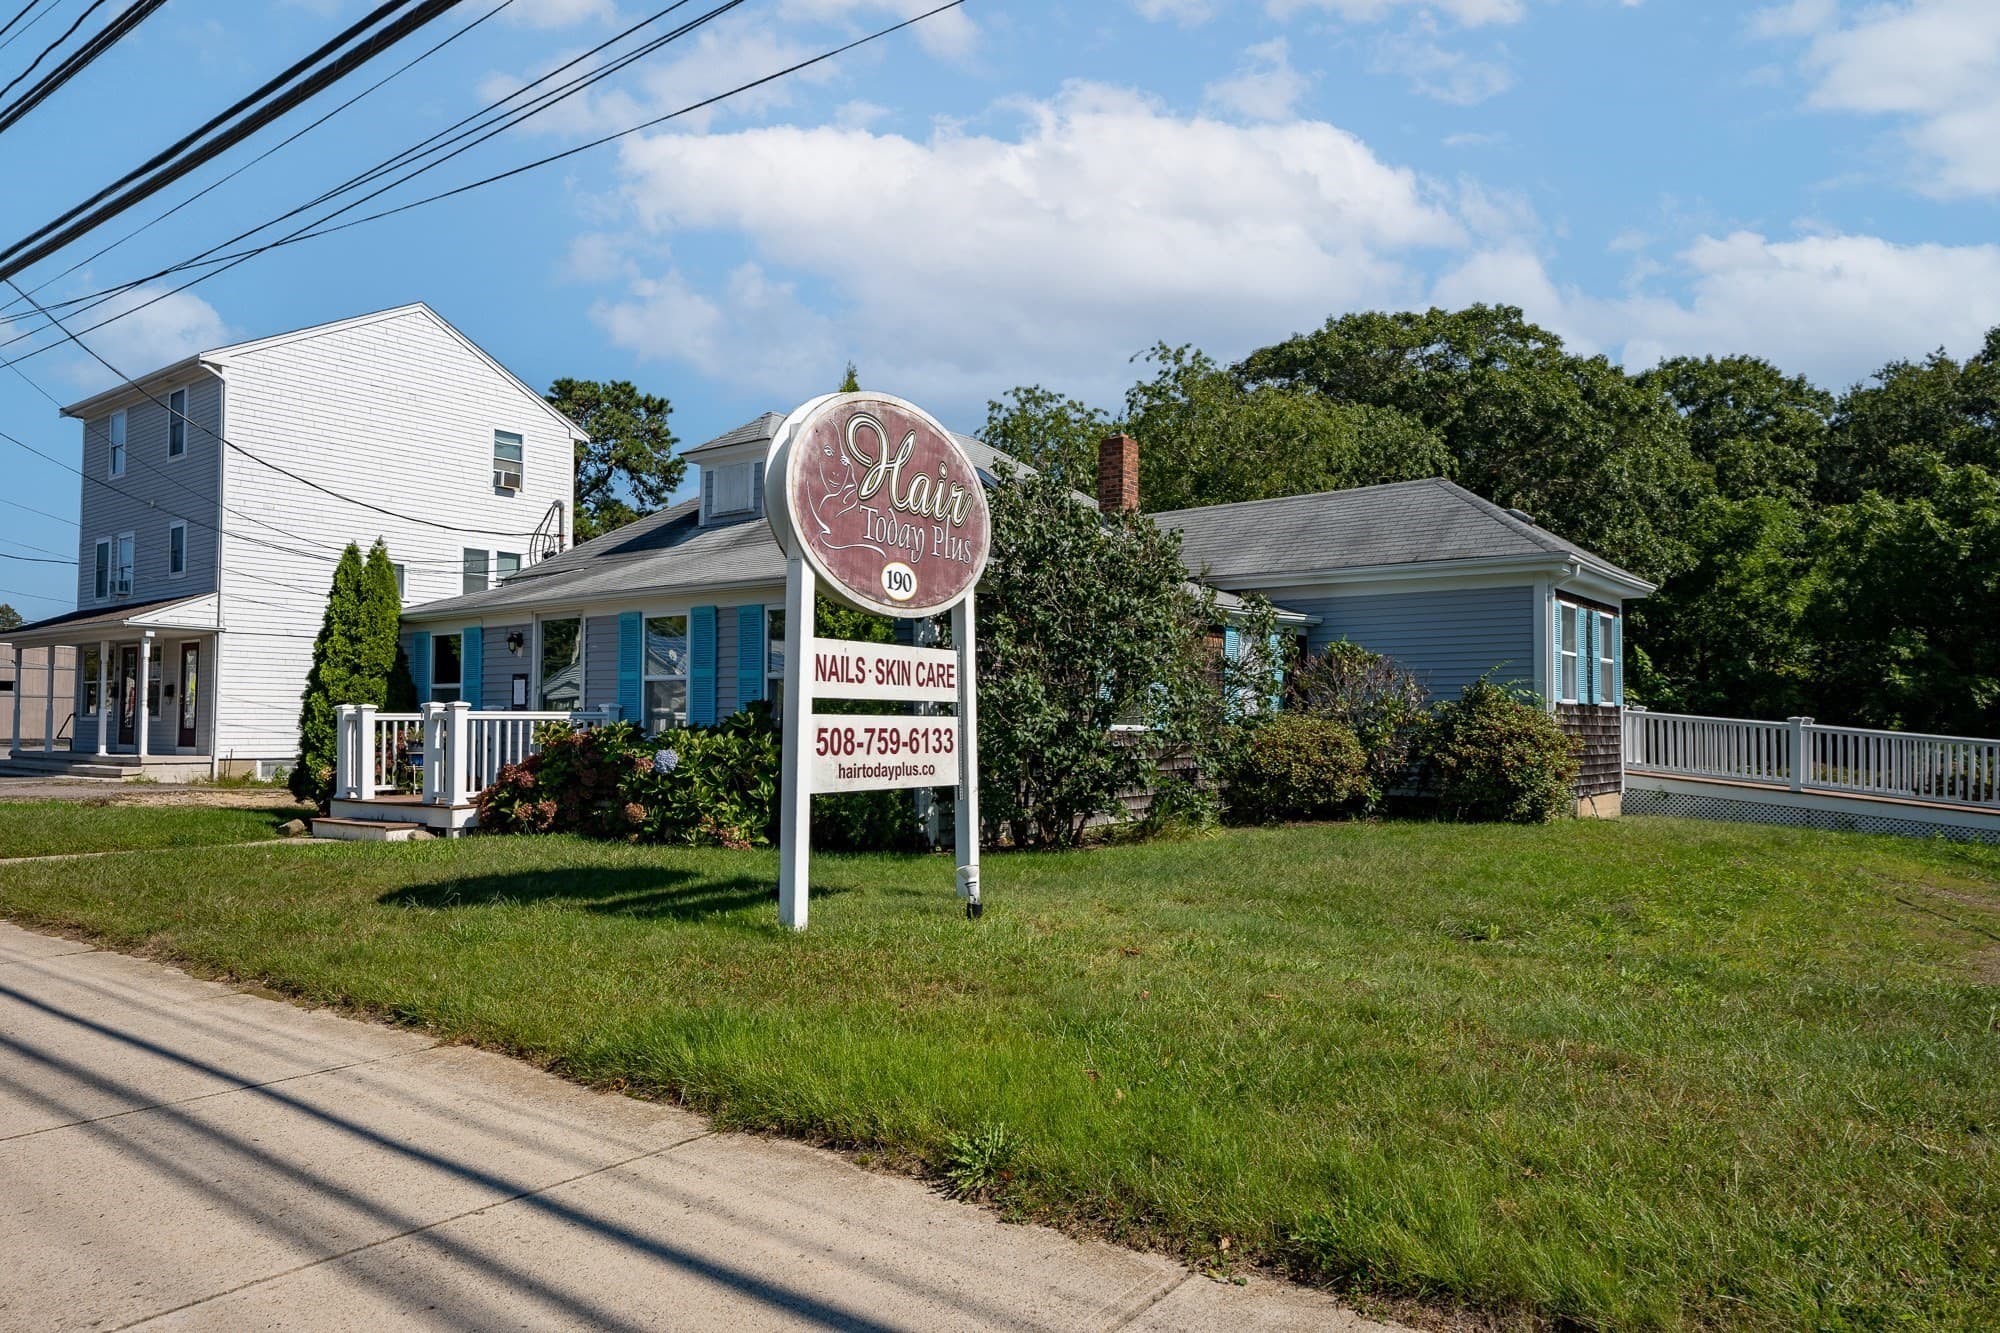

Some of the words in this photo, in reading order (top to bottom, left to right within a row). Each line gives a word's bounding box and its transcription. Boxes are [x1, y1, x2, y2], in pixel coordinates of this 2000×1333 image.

[845, 411, 973, 527] Hair
[859, 504, 925, 563] Today
[931, 513, 972, 564] Plus
[886, 569, 912, 592] 190
[815, 653, 866, 684] NAILS
[875, 658, 911, 686] SKIN
[915, 661, 955, 688] CARE
[815, 727, 954, 756] 508-759-6133
[838, 761, 935, 781] hairtodayplus.co
